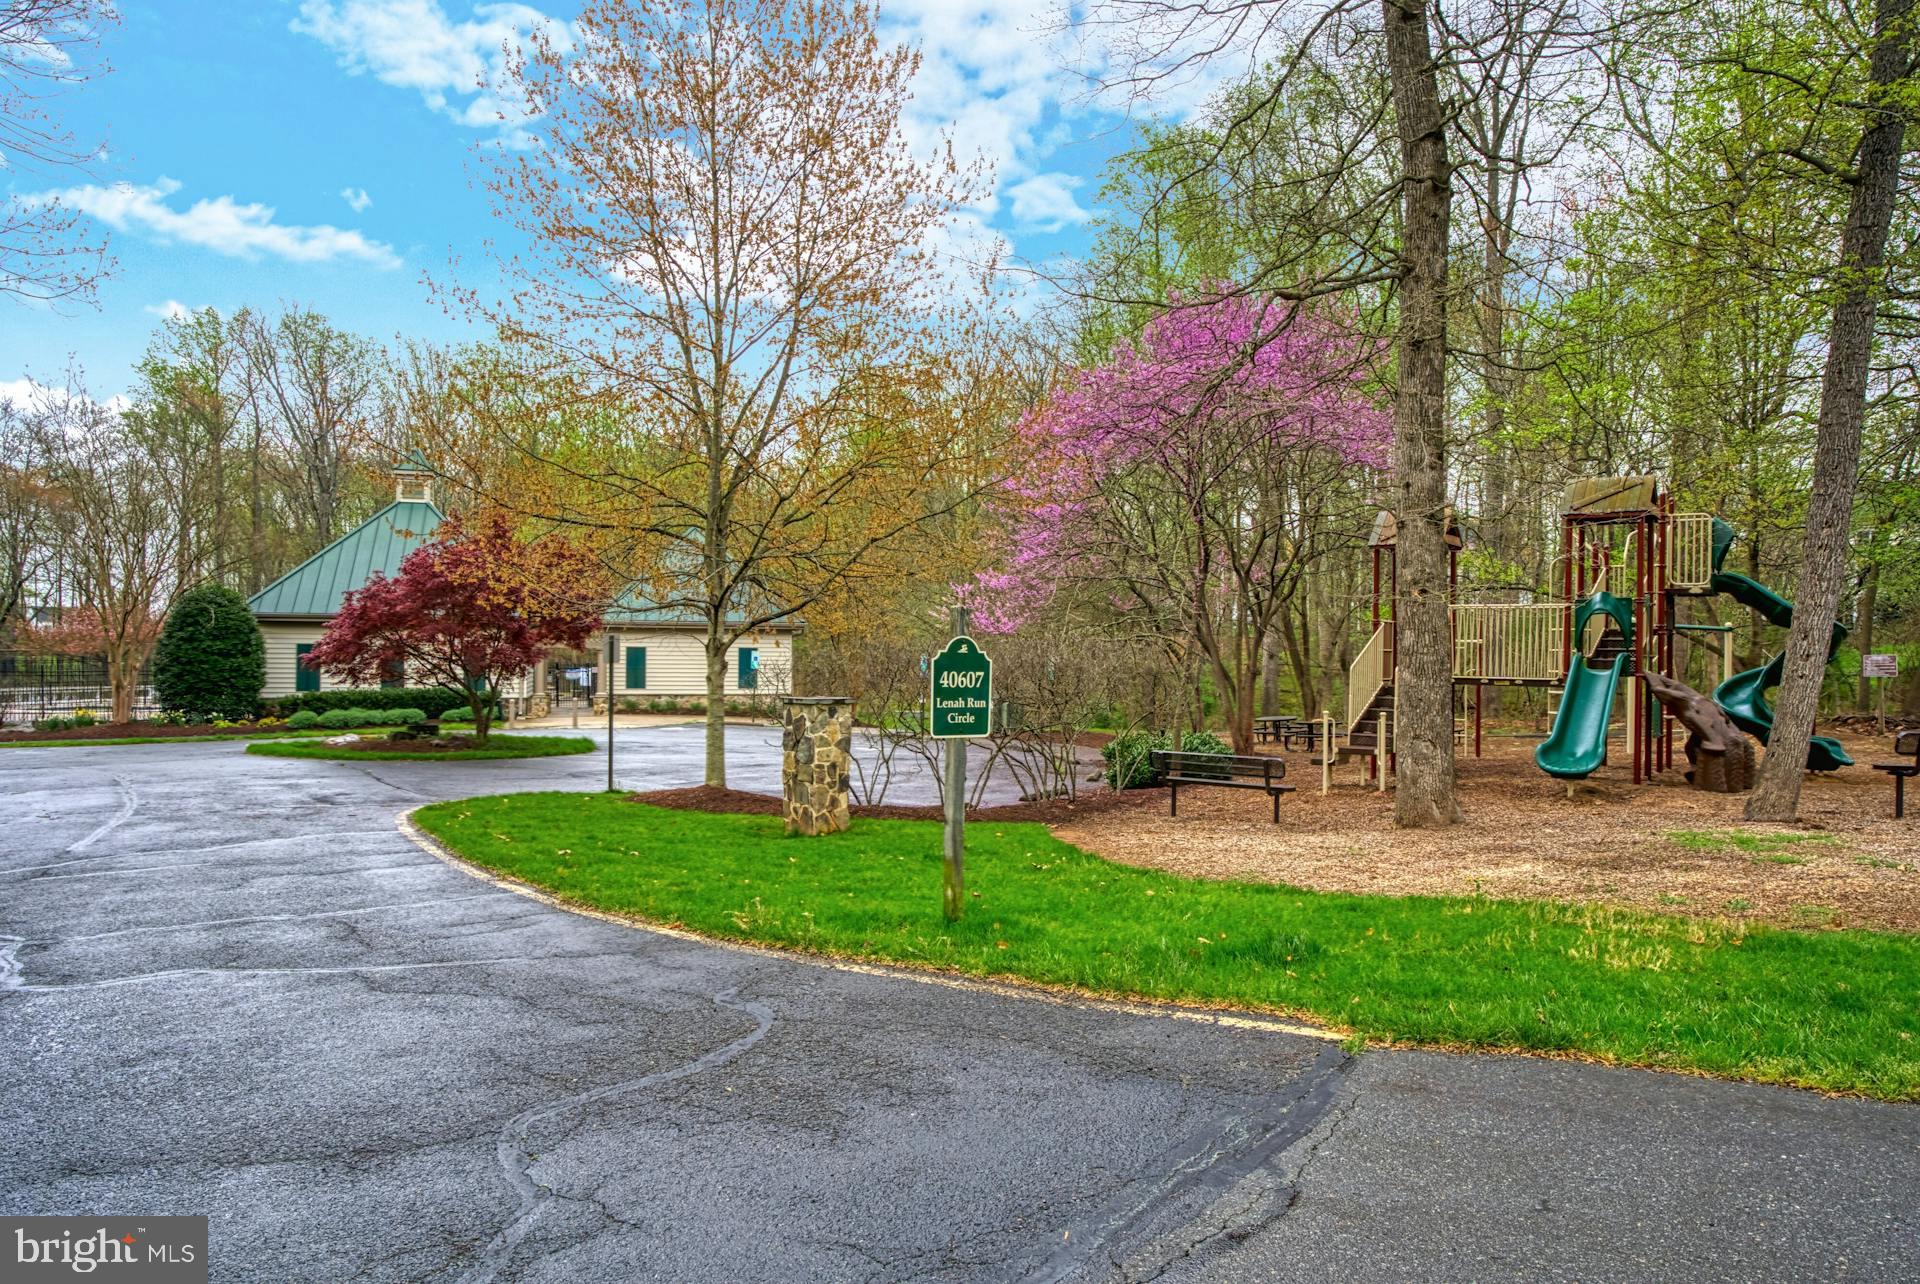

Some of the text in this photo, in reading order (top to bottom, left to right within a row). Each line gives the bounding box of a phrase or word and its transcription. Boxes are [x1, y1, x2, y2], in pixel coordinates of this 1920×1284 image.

[940, 671, 984, 688] 40607
[936, 697, 986, 708] Lenah Run
[947, 713, 975, 723] Circle
